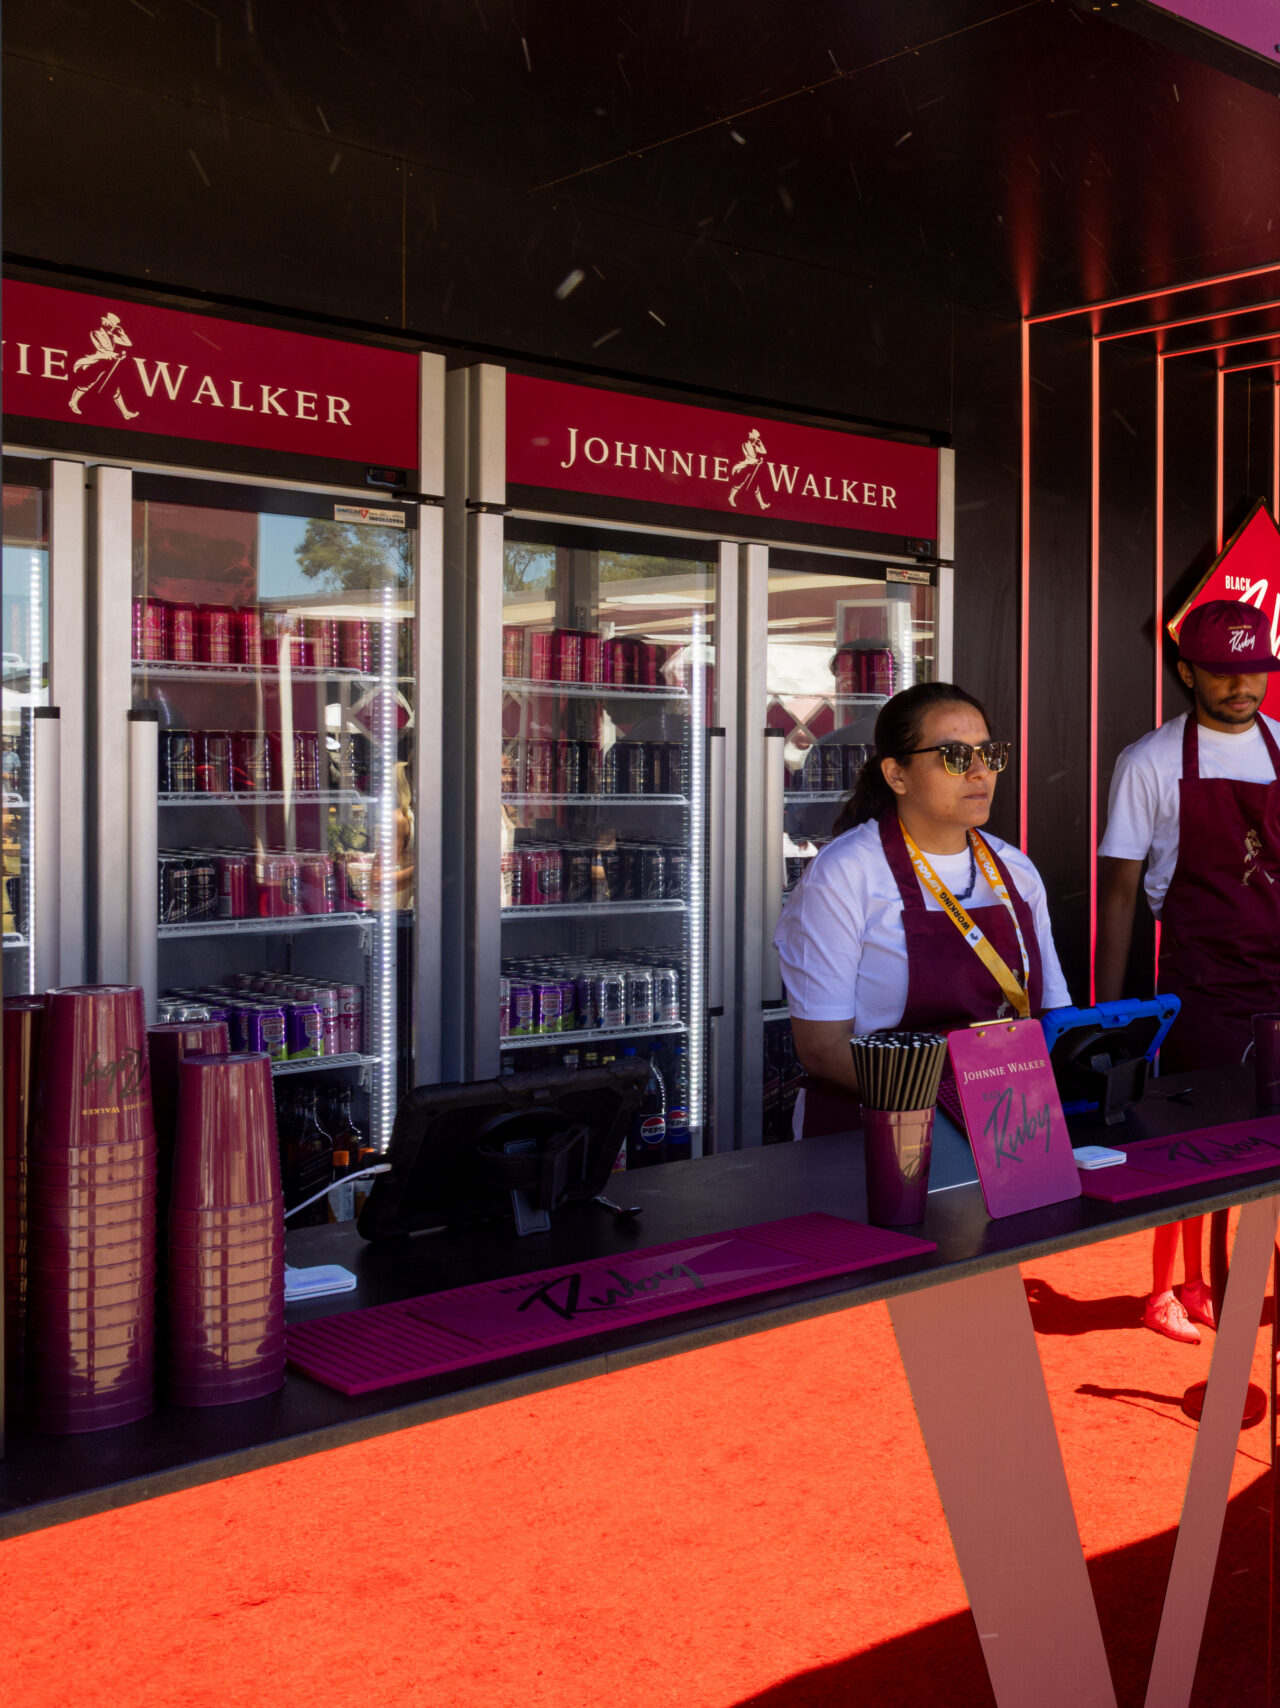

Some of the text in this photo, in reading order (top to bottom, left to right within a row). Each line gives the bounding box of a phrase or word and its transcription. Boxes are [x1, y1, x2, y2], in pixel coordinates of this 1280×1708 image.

[2, 341, 352, 425] IE WALKER
[561, 427, 897, 510] JOHNNIE WALKER
[1225, 575, 1251, 592] BLACK
[1229, 630, 1256, 652] Ruby
[939, 891, 970, 931] WORKING
[963, 1059, 1046, 1085] JOHNNIE WALKER
[983, 1087, 1051, 1168] Ruby
[516, 1264, 705, 1320] Ruby
